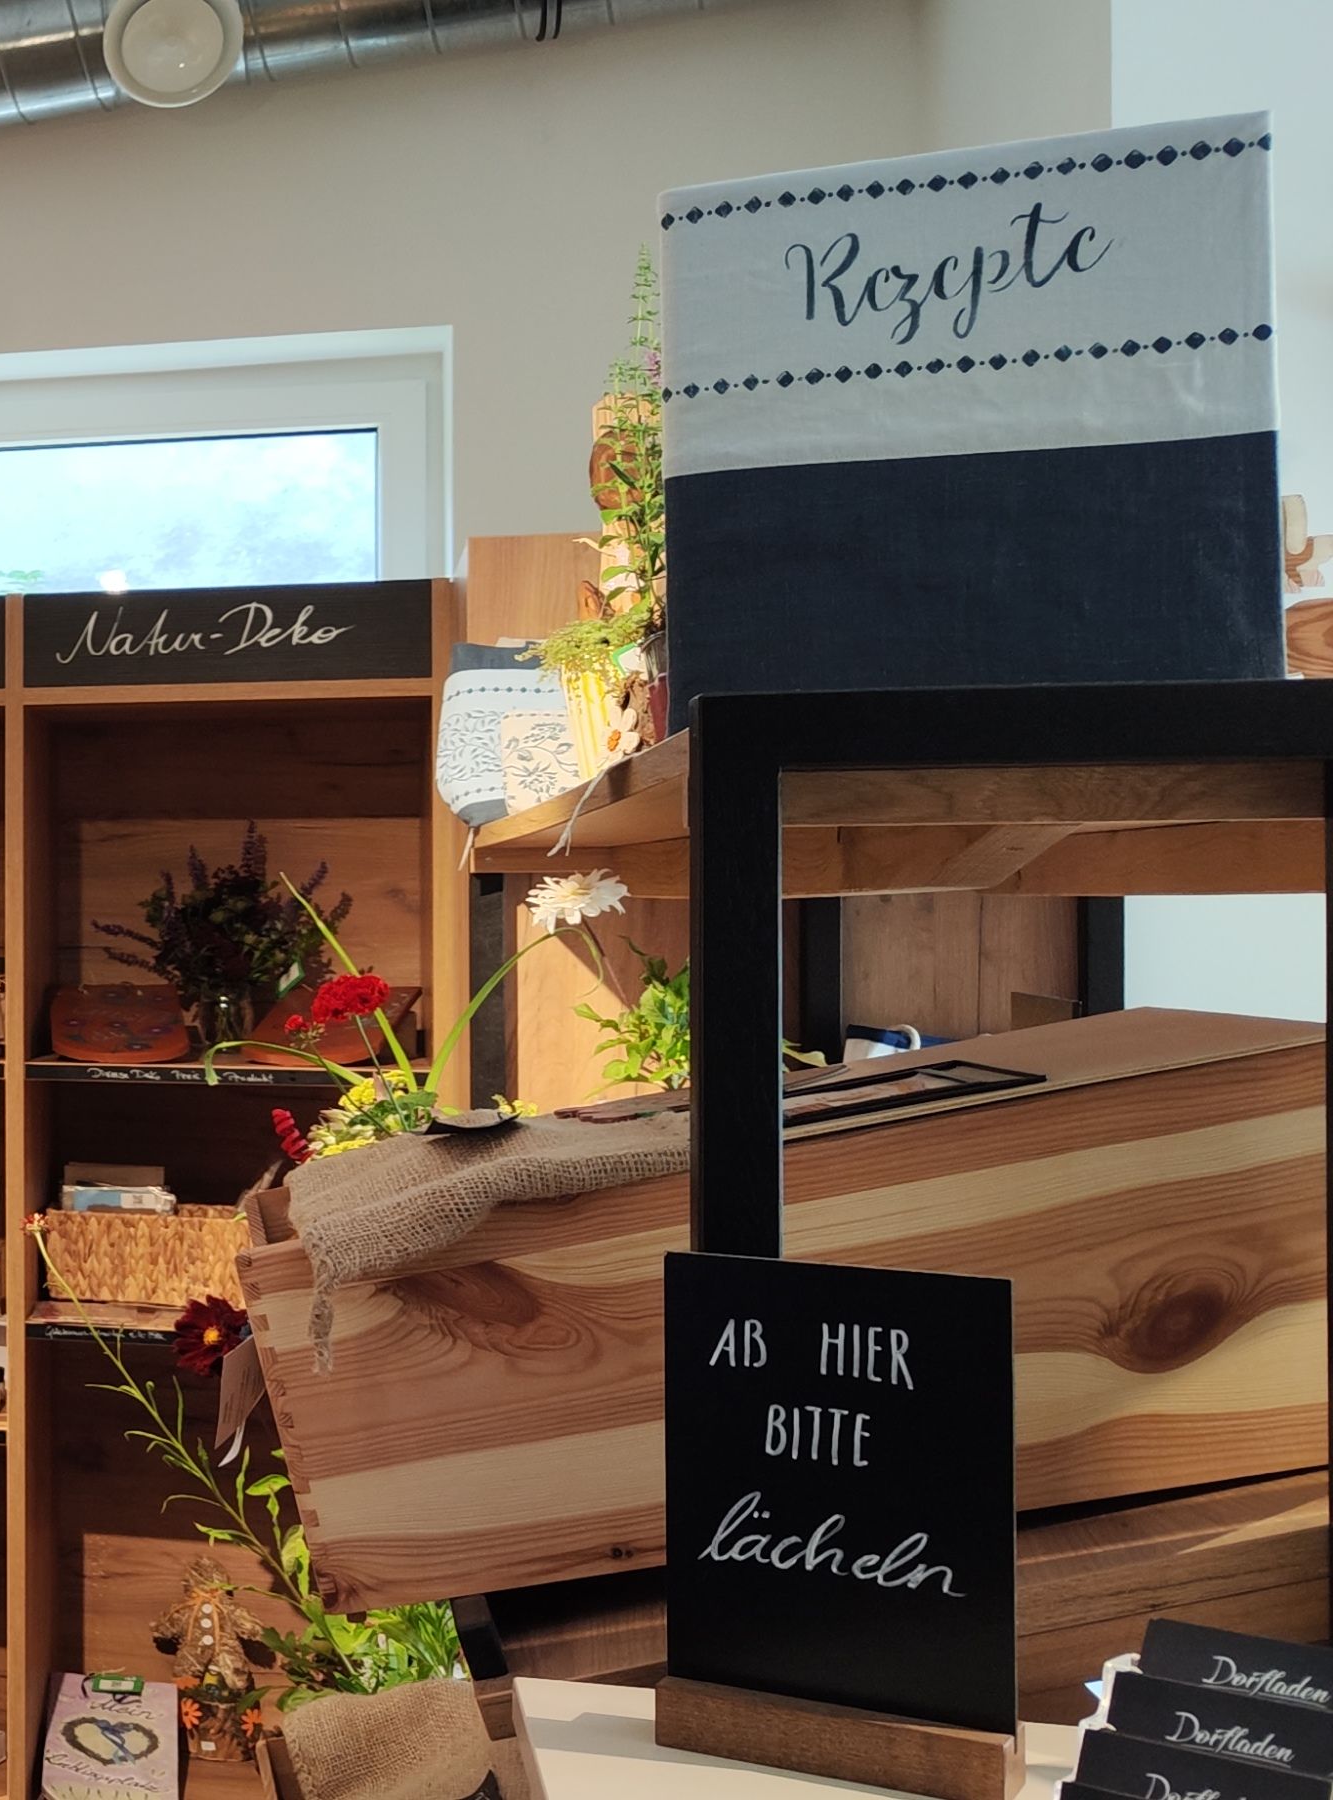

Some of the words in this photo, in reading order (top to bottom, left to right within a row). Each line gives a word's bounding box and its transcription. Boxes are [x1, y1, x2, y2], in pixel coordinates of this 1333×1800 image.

[785, 201, 1117, 344] Rezepte
[57, 604, 353, 664] Natur-Deko
[709, 1319, 768, 1368] AB
[819, 1321, 915, 1391] HIER
[764, 1403, 872, 1468] BITTE
[697, 1491, 968, 1598] lächeln
[1202, 1655, 1330, 1706] Dorfladen
[1165, 1710, 1296, 1763] Dorfladen
